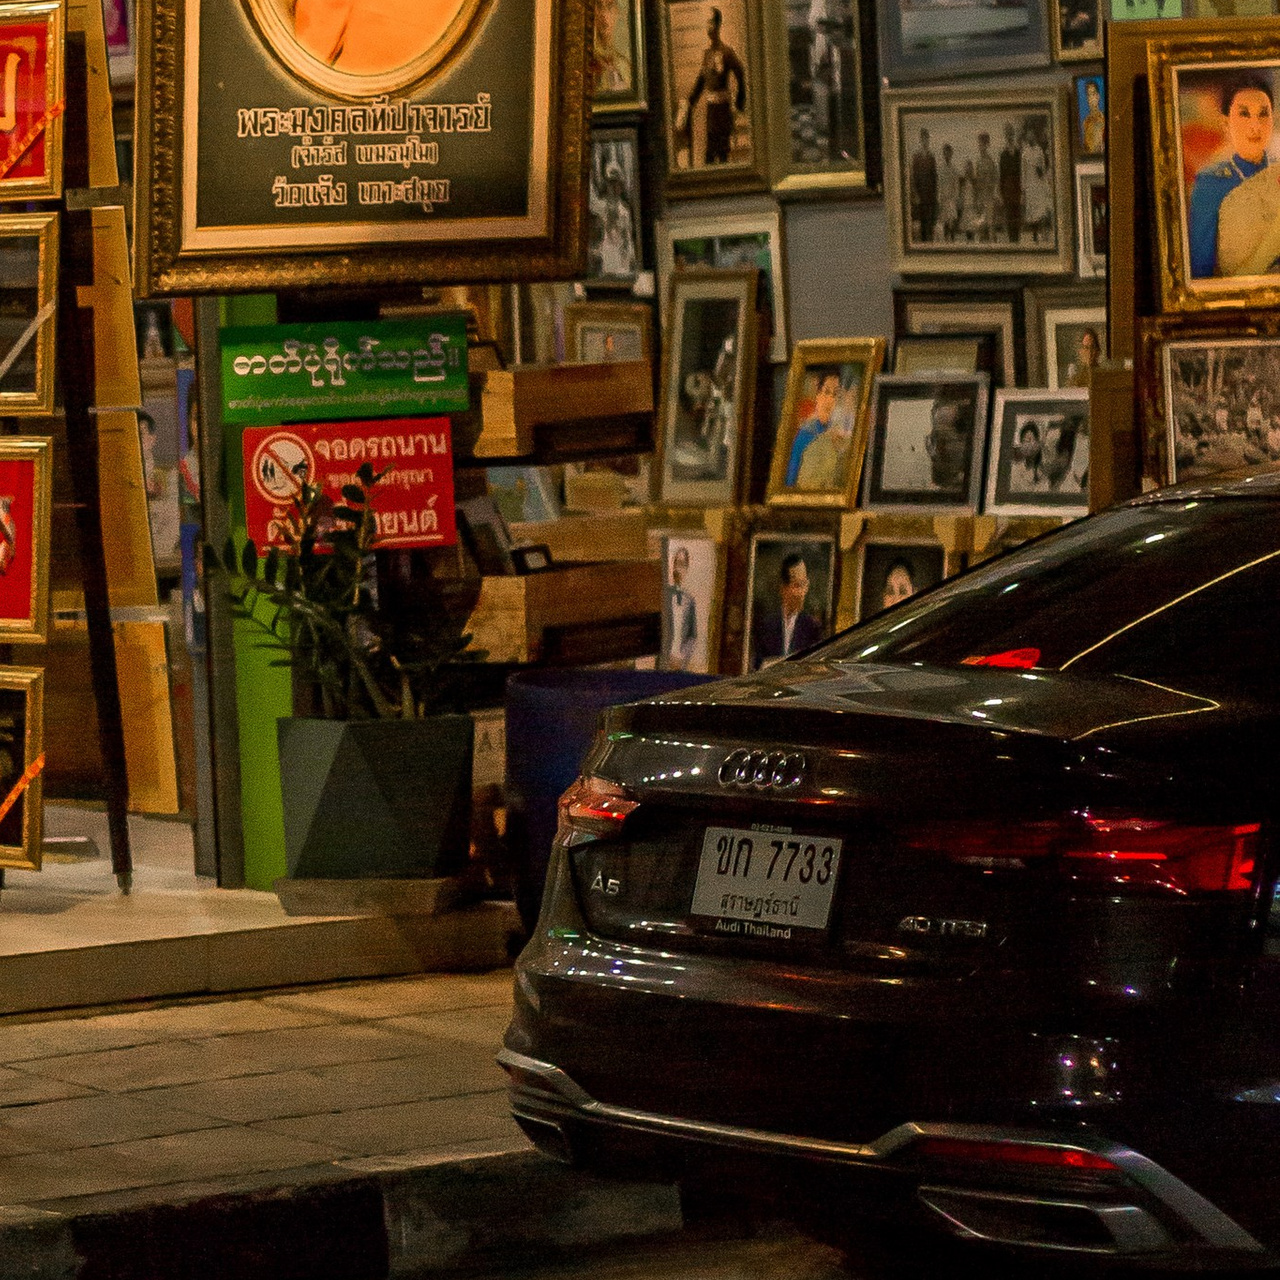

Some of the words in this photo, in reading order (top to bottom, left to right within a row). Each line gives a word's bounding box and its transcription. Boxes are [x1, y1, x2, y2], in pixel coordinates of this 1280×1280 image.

[271, 175, 349, 208] วัดแจ้ง
[358, 176, 451, 213] เกาะสมุย
[314, 434, 447, 460] จอดรถนาน
[767, 840, 834, 886] 7733
[589, 870, 620, 895] A5
[721, 890, 801, 918] สุราษฎร์ธานี
[715, 918, 741, 932] Audi
[744, 921, 792, 939] Thailand
